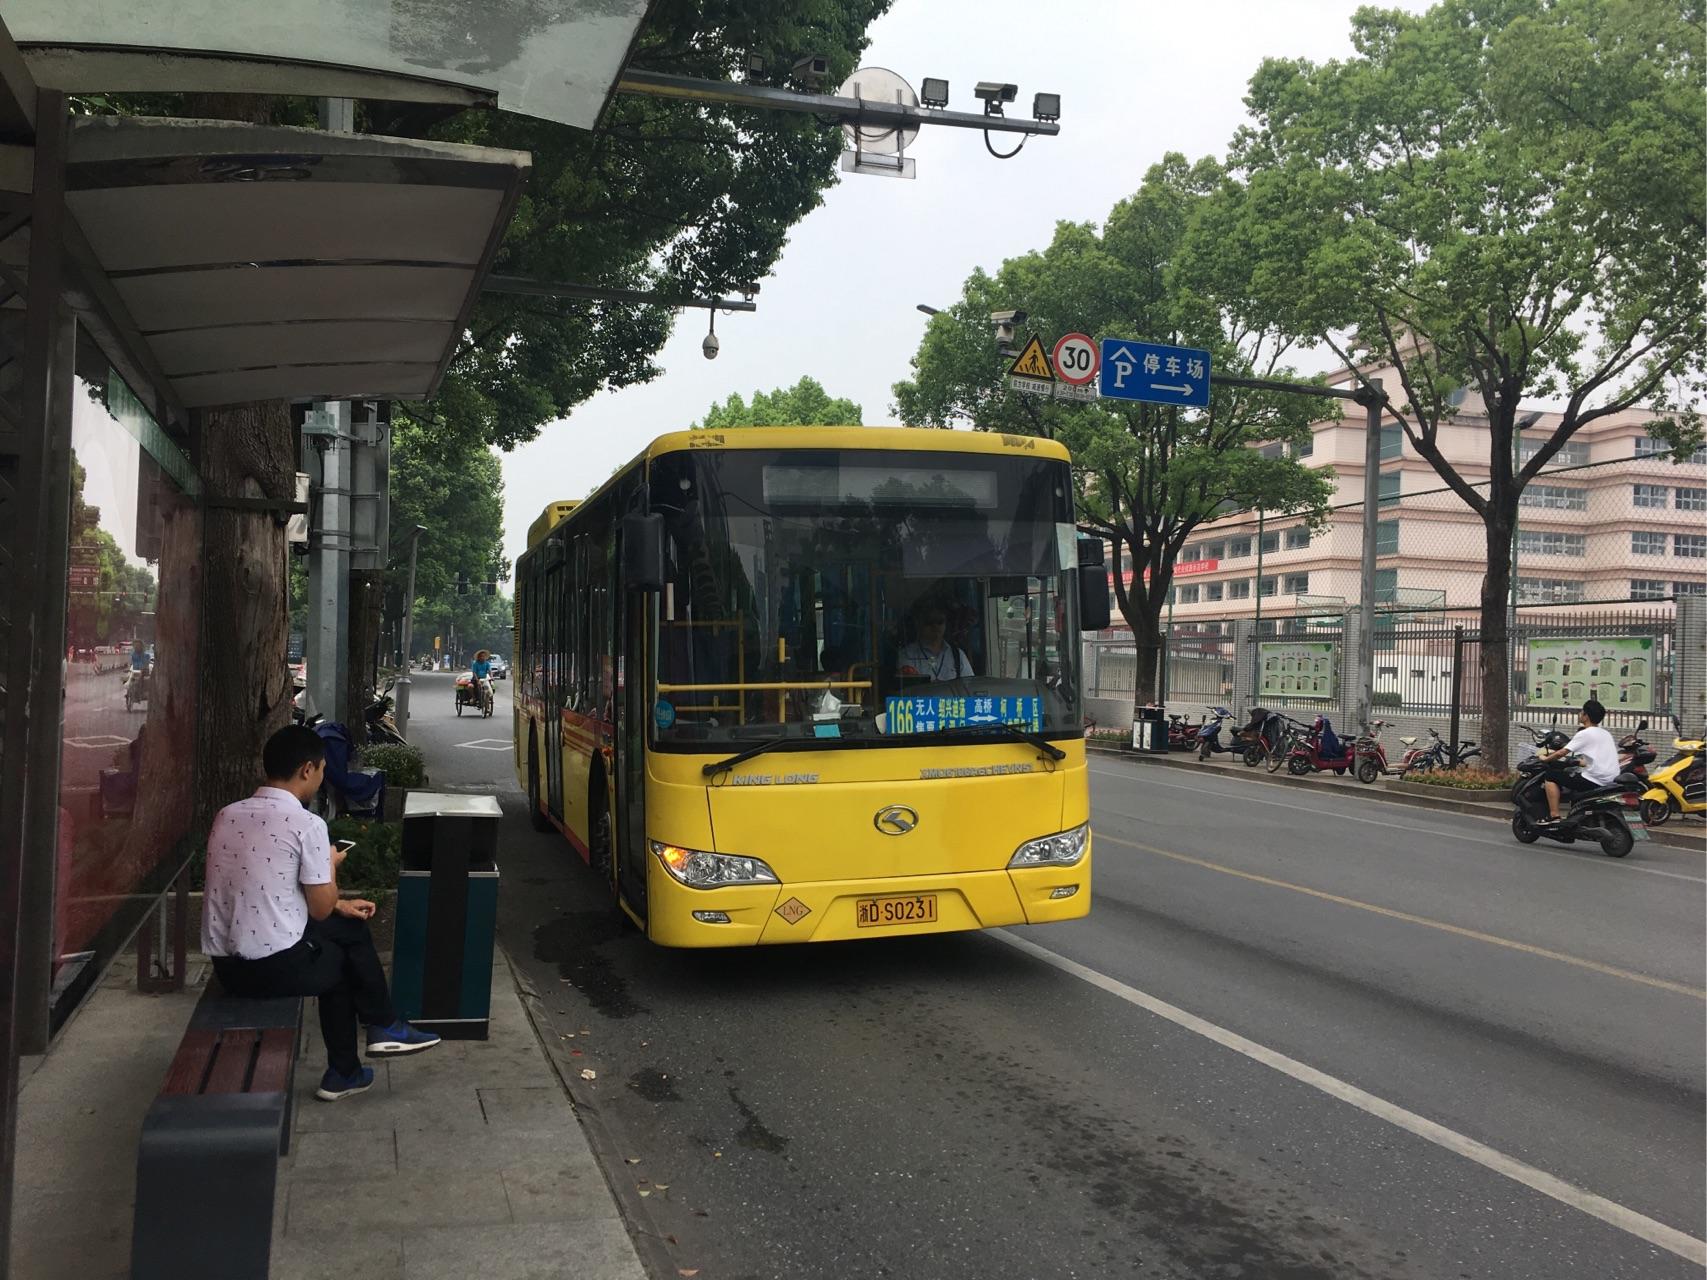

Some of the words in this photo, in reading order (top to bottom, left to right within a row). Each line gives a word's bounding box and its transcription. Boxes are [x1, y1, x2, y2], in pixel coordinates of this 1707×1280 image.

[1062, 346, 1090, 371] 30
[1143, 353, 1204, 380] 停车场
[1114, 361, 1133, 388] P
[889, 700, 914, 734] 166
[915, 699, 935, 716] 无人
[974, 698, 992, 714] 高桥
[732, 775, 771, 785] KING
[776, 773, 818, 784] LONG
[783, 904, 803, 916] LNG
